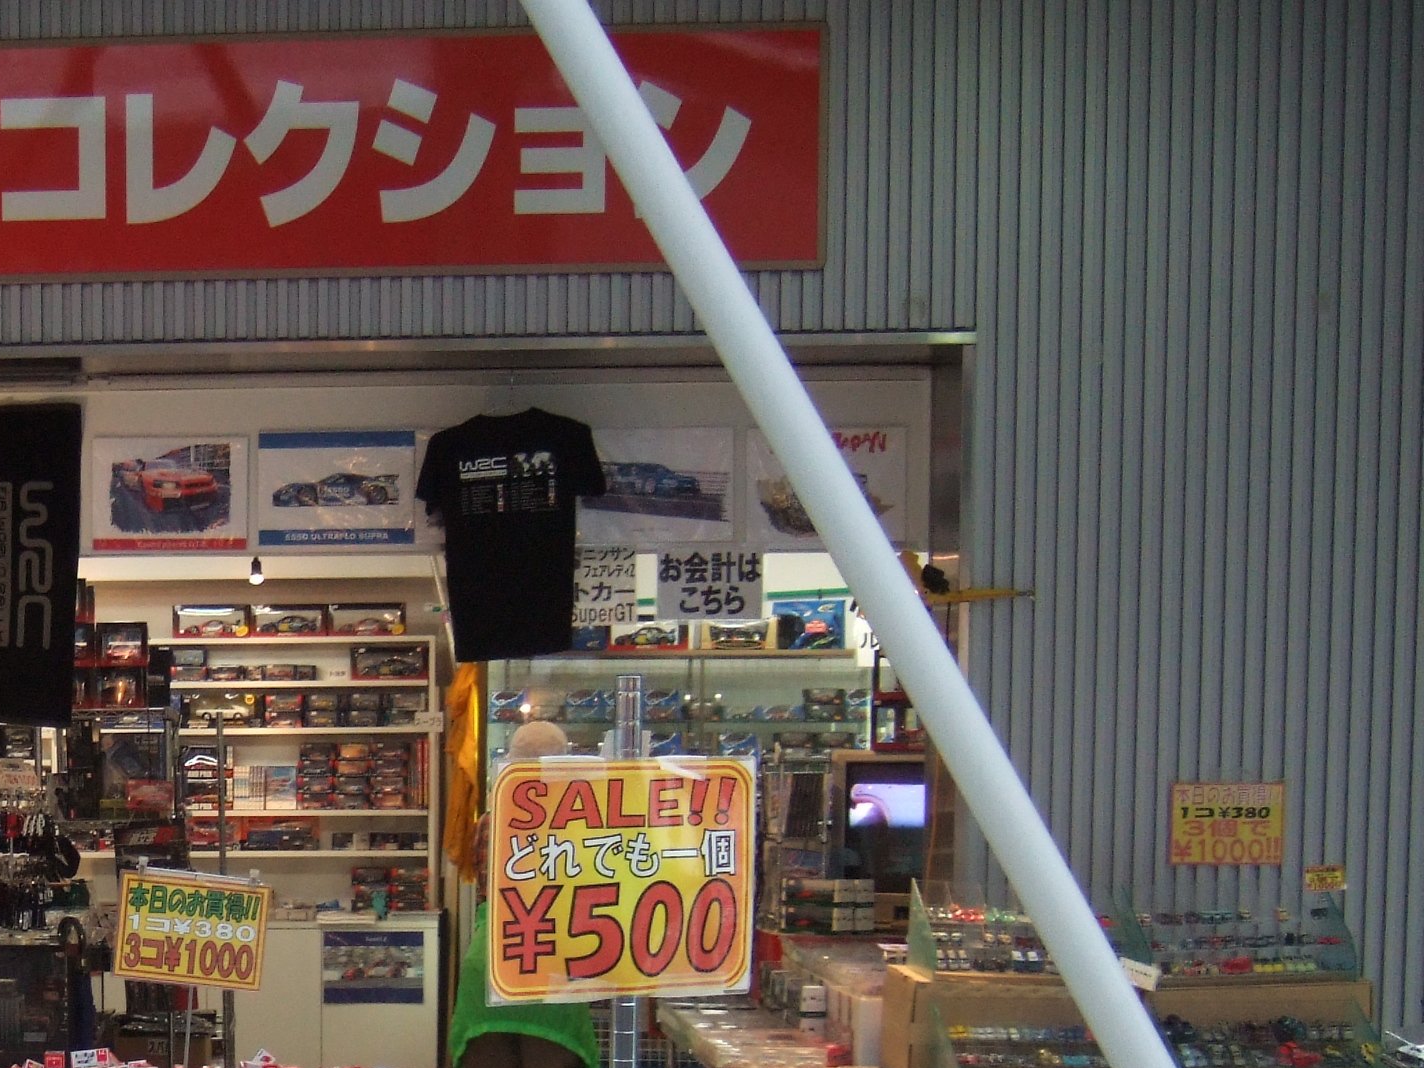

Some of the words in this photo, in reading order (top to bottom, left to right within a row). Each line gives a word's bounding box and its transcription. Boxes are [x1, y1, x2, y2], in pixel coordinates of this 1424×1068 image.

[659, 552, 761, 583] お会計は
[679, 585, 746, 615] こちら
[508, 777, 738, 830] SALE!!
[504, 829, 736, 881] どれでも一個
[499, 878, 737, 981] ¥500
